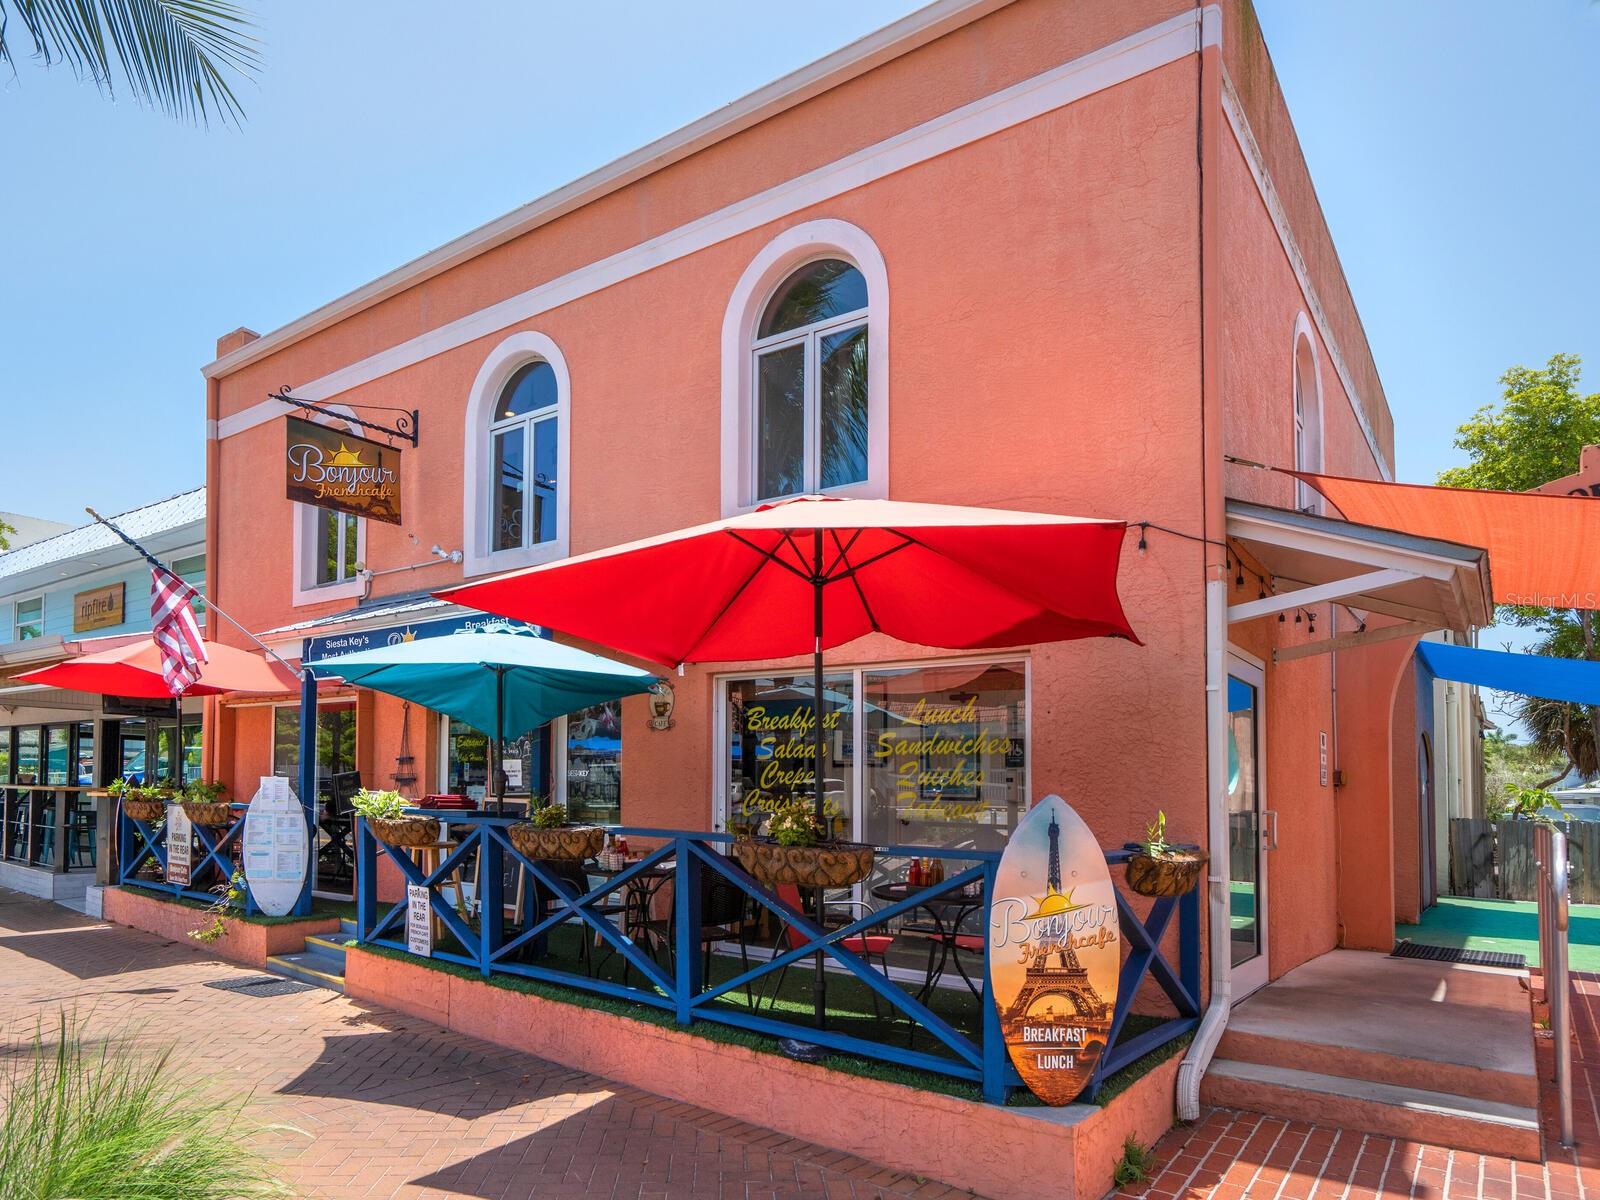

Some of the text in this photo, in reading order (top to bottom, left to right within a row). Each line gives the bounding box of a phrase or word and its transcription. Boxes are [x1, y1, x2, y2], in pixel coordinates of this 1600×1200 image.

[288, 444, 396, 493] Bonjour
[81, 599, 107, 620] ripfire
[326, 635, 369, 649] Siesta Key's
[903, 695, 978, 725] Lunch
[874, 728, 1011, 757] Sandwiches
[896, 759, 986, 788] Quiches
[172, 832, 186, 842] PARKING
[180, 844, 189, 855] REAR
[409, 888, 428, 899] PARKING
[412, 901, 426, 911] IN THE
[413, 912, 425, 921] REAR
[991, 896, 1119, 948] Bonjour
[410, 937, 429, 946] CUSTOMERS
[1023, 1026, 1087, 1043] BREAKFAST
[1037, 1053, 1074, 1070] LUNCH
